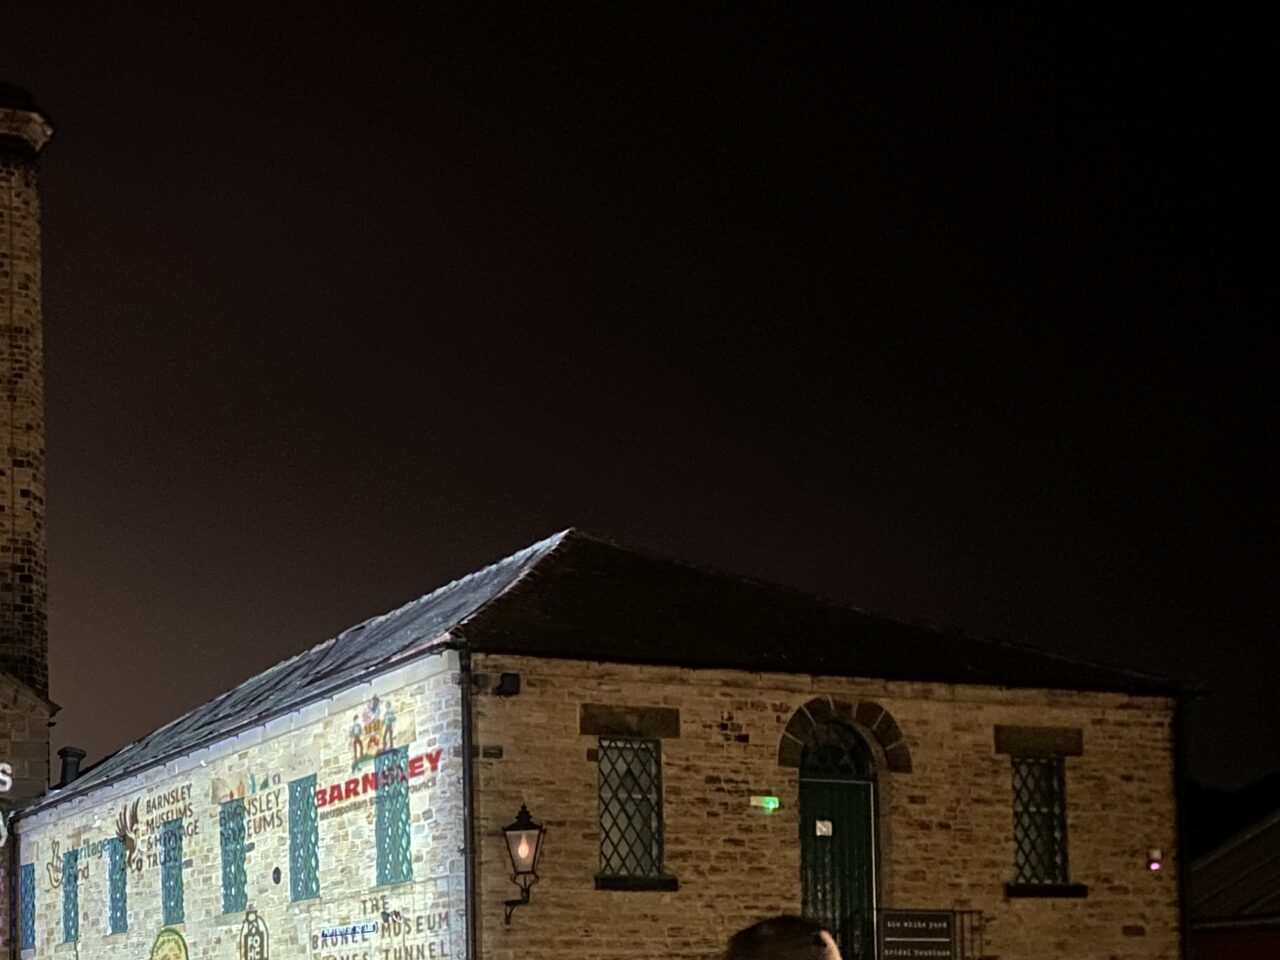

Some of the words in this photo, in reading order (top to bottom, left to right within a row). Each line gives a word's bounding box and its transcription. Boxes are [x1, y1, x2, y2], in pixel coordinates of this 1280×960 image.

[314, 749, 443, 809] BARNSLEY
[146, 783, 192, 814] BARNSLEY
[146, 802, 194, 833] MUSEUMS
[66, 837, 110, 861] ritage
[147, 836, 153, 851] &
[155, 819, 200, 849] HAGE
[361, 895, 389, 914] THE
[381, 911, 450, 939] MUSEUM
